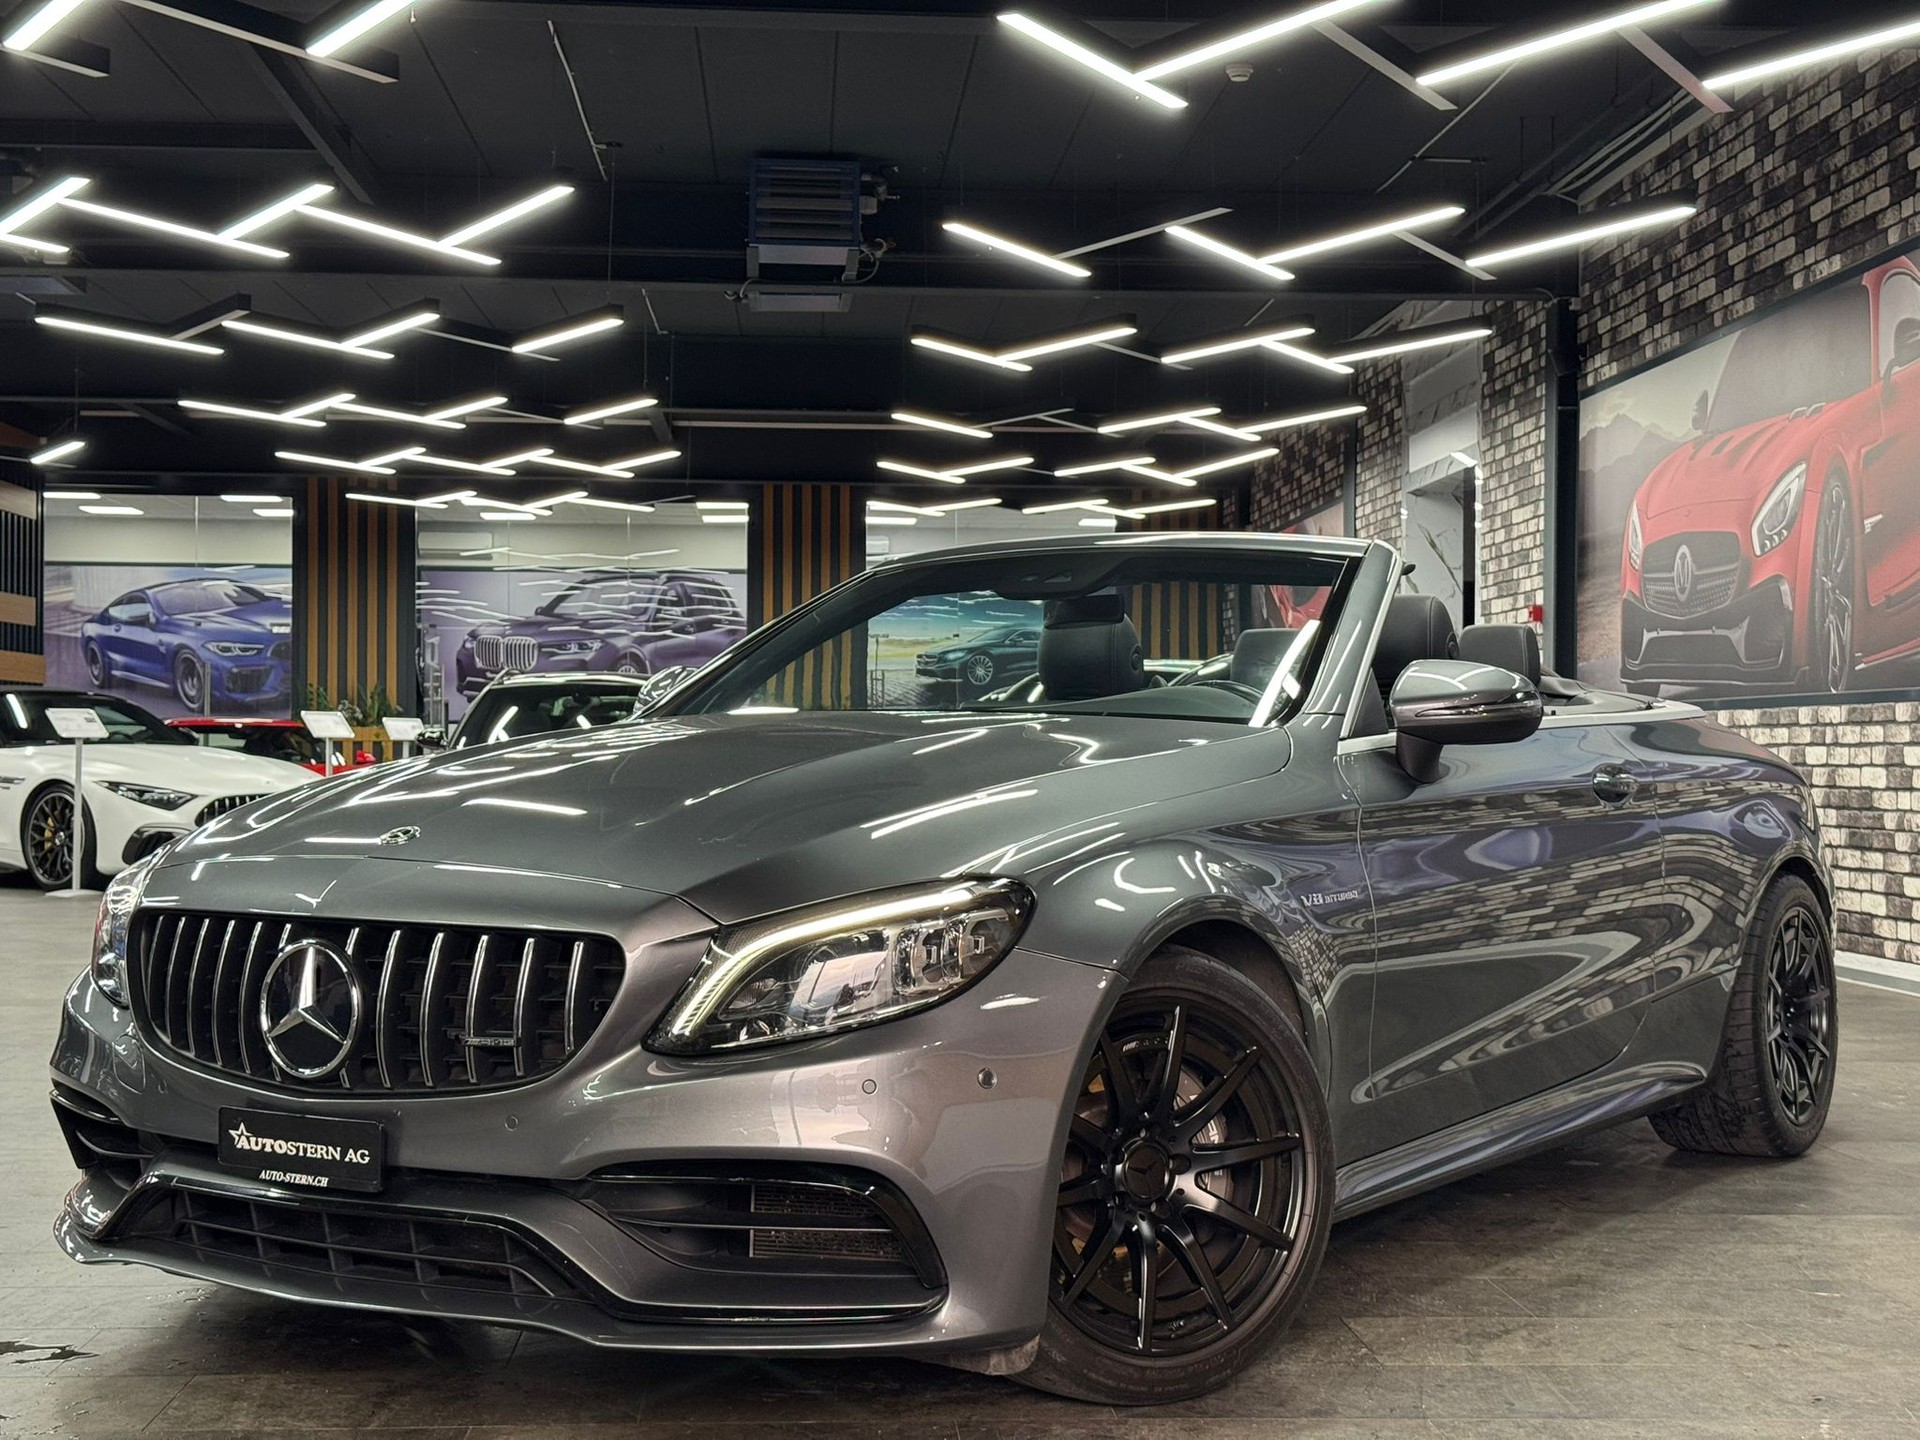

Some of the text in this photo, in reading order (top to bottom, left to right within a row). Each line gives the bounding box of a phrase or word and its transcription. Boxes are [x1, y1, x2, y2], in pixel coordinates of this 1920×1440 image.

[1300, 890, 1358, 907] V8 BITURBO
[236, 1136, 371, 1164] AUTOSTERN AG
[259, 1169, 329, 1187] AUTO-STERN.CH
